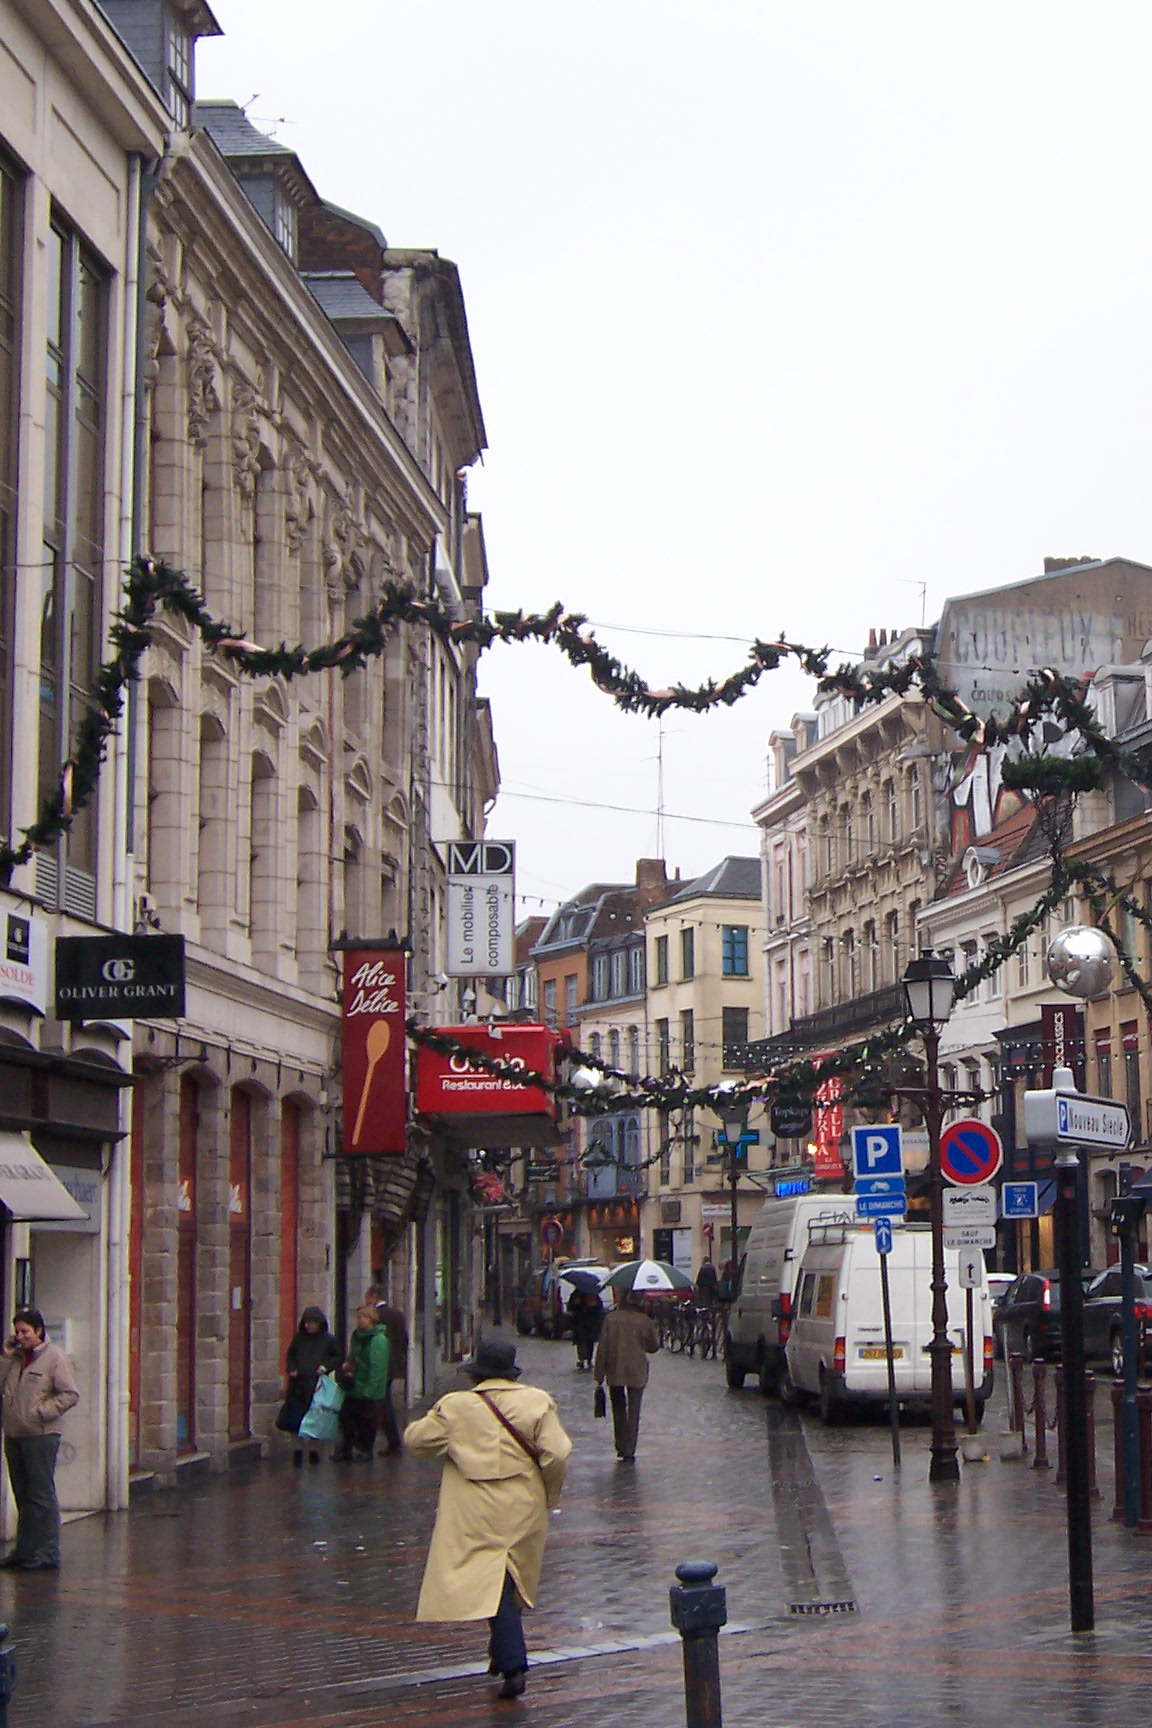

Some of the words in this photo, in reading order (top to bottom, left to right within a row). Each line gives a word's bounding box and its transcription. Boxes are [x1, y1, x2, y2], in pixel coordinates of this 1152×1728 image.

[451, 843, 511, 873] MD
[461, 947, 473, 963] Le
[350, 960, 397, 988] Alice
[59, 986, 119, 999] OLIVER
[124, 984, 177, 997] GRANT
[346, 987, 400, 1017] Délice
[442, 1079, 501, 1091] Restaurant
[1069, 1106, 1099, 1133] Nouveau
[1102, 1114, 1123, 1136] Siècle
[866, 1135, 889, 1168] P
[859, 1202, 868, 1211] LE
[869, 1200, 904, 1210] DIMANCHE
